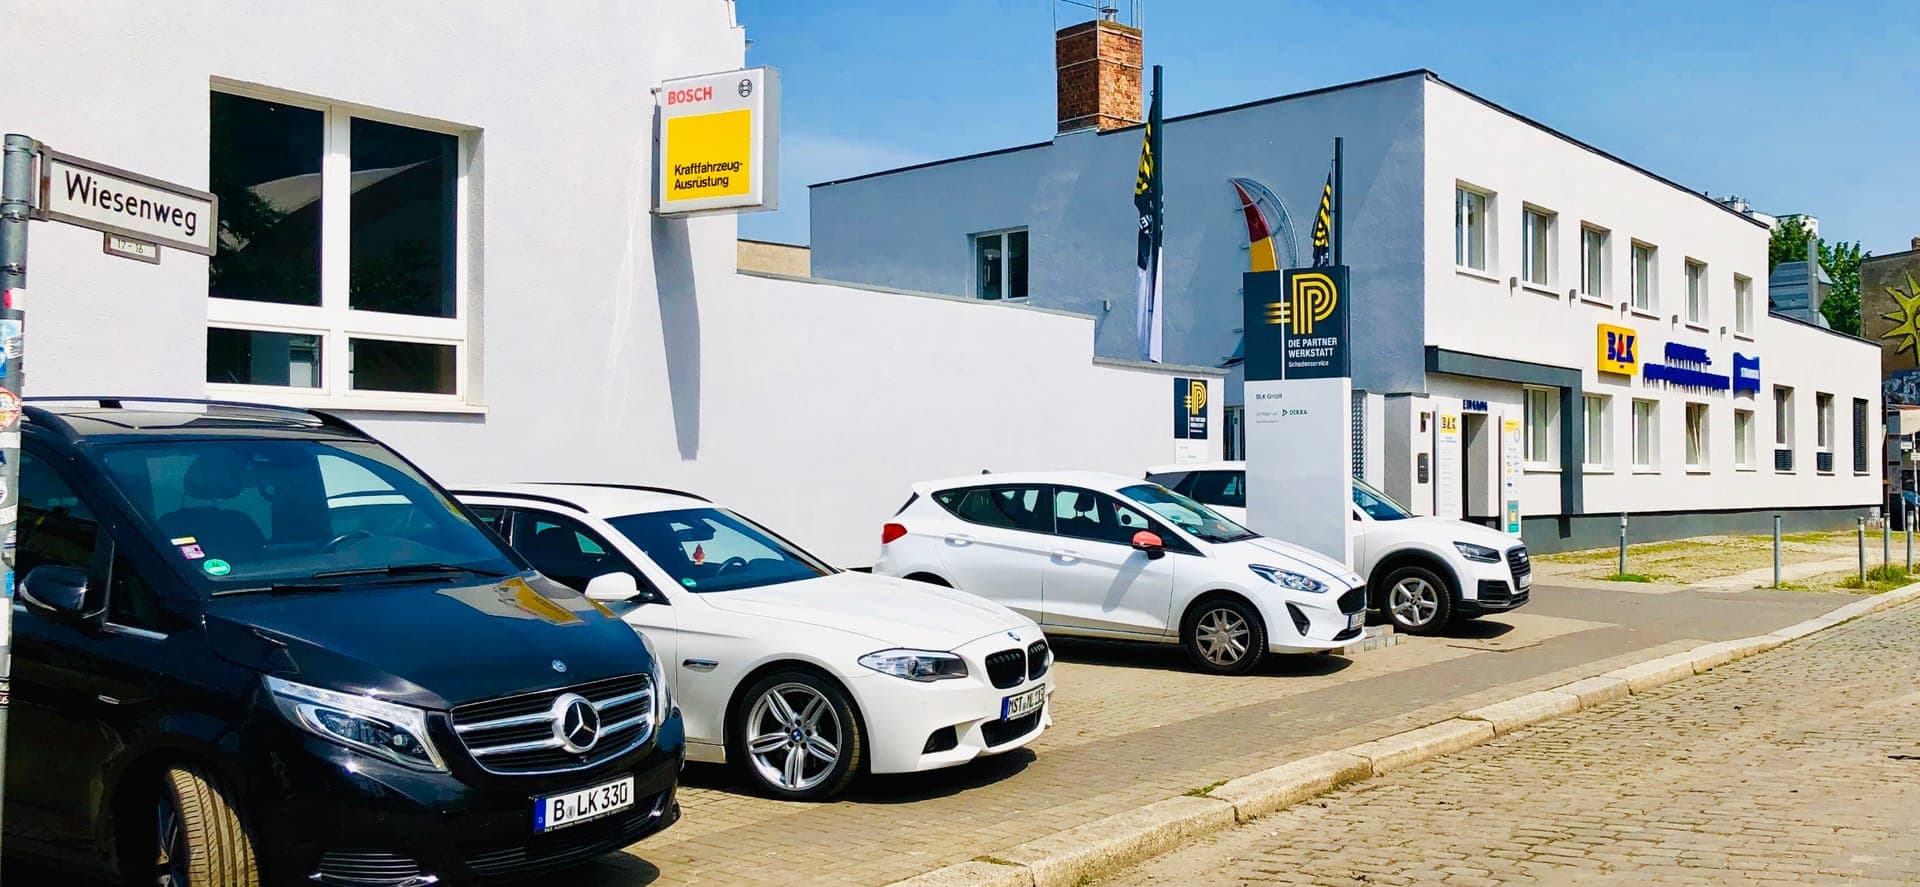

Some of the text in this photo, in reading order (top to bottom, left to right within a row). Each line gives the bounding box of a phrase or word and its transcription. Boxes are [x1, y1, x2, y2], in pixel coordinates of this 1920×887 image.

[668, 86, 712, 105] BOSCH
[674, 161, 743, 176] Kraftfahrzeug-
[674, 176, 729, 190] Ausrüstung
[65, 170, 197, 236] Wiesenweg
[1288, 337, 1338, 348] DIE PARTNER
[1607, 331, 1635, 363] BLK
[1288, 348, 1333, 358] WERKSTATT
[553, 799, 565, 822] B
[577, 790, 599, 816] LK
[601, 782, 628, 809] 330
